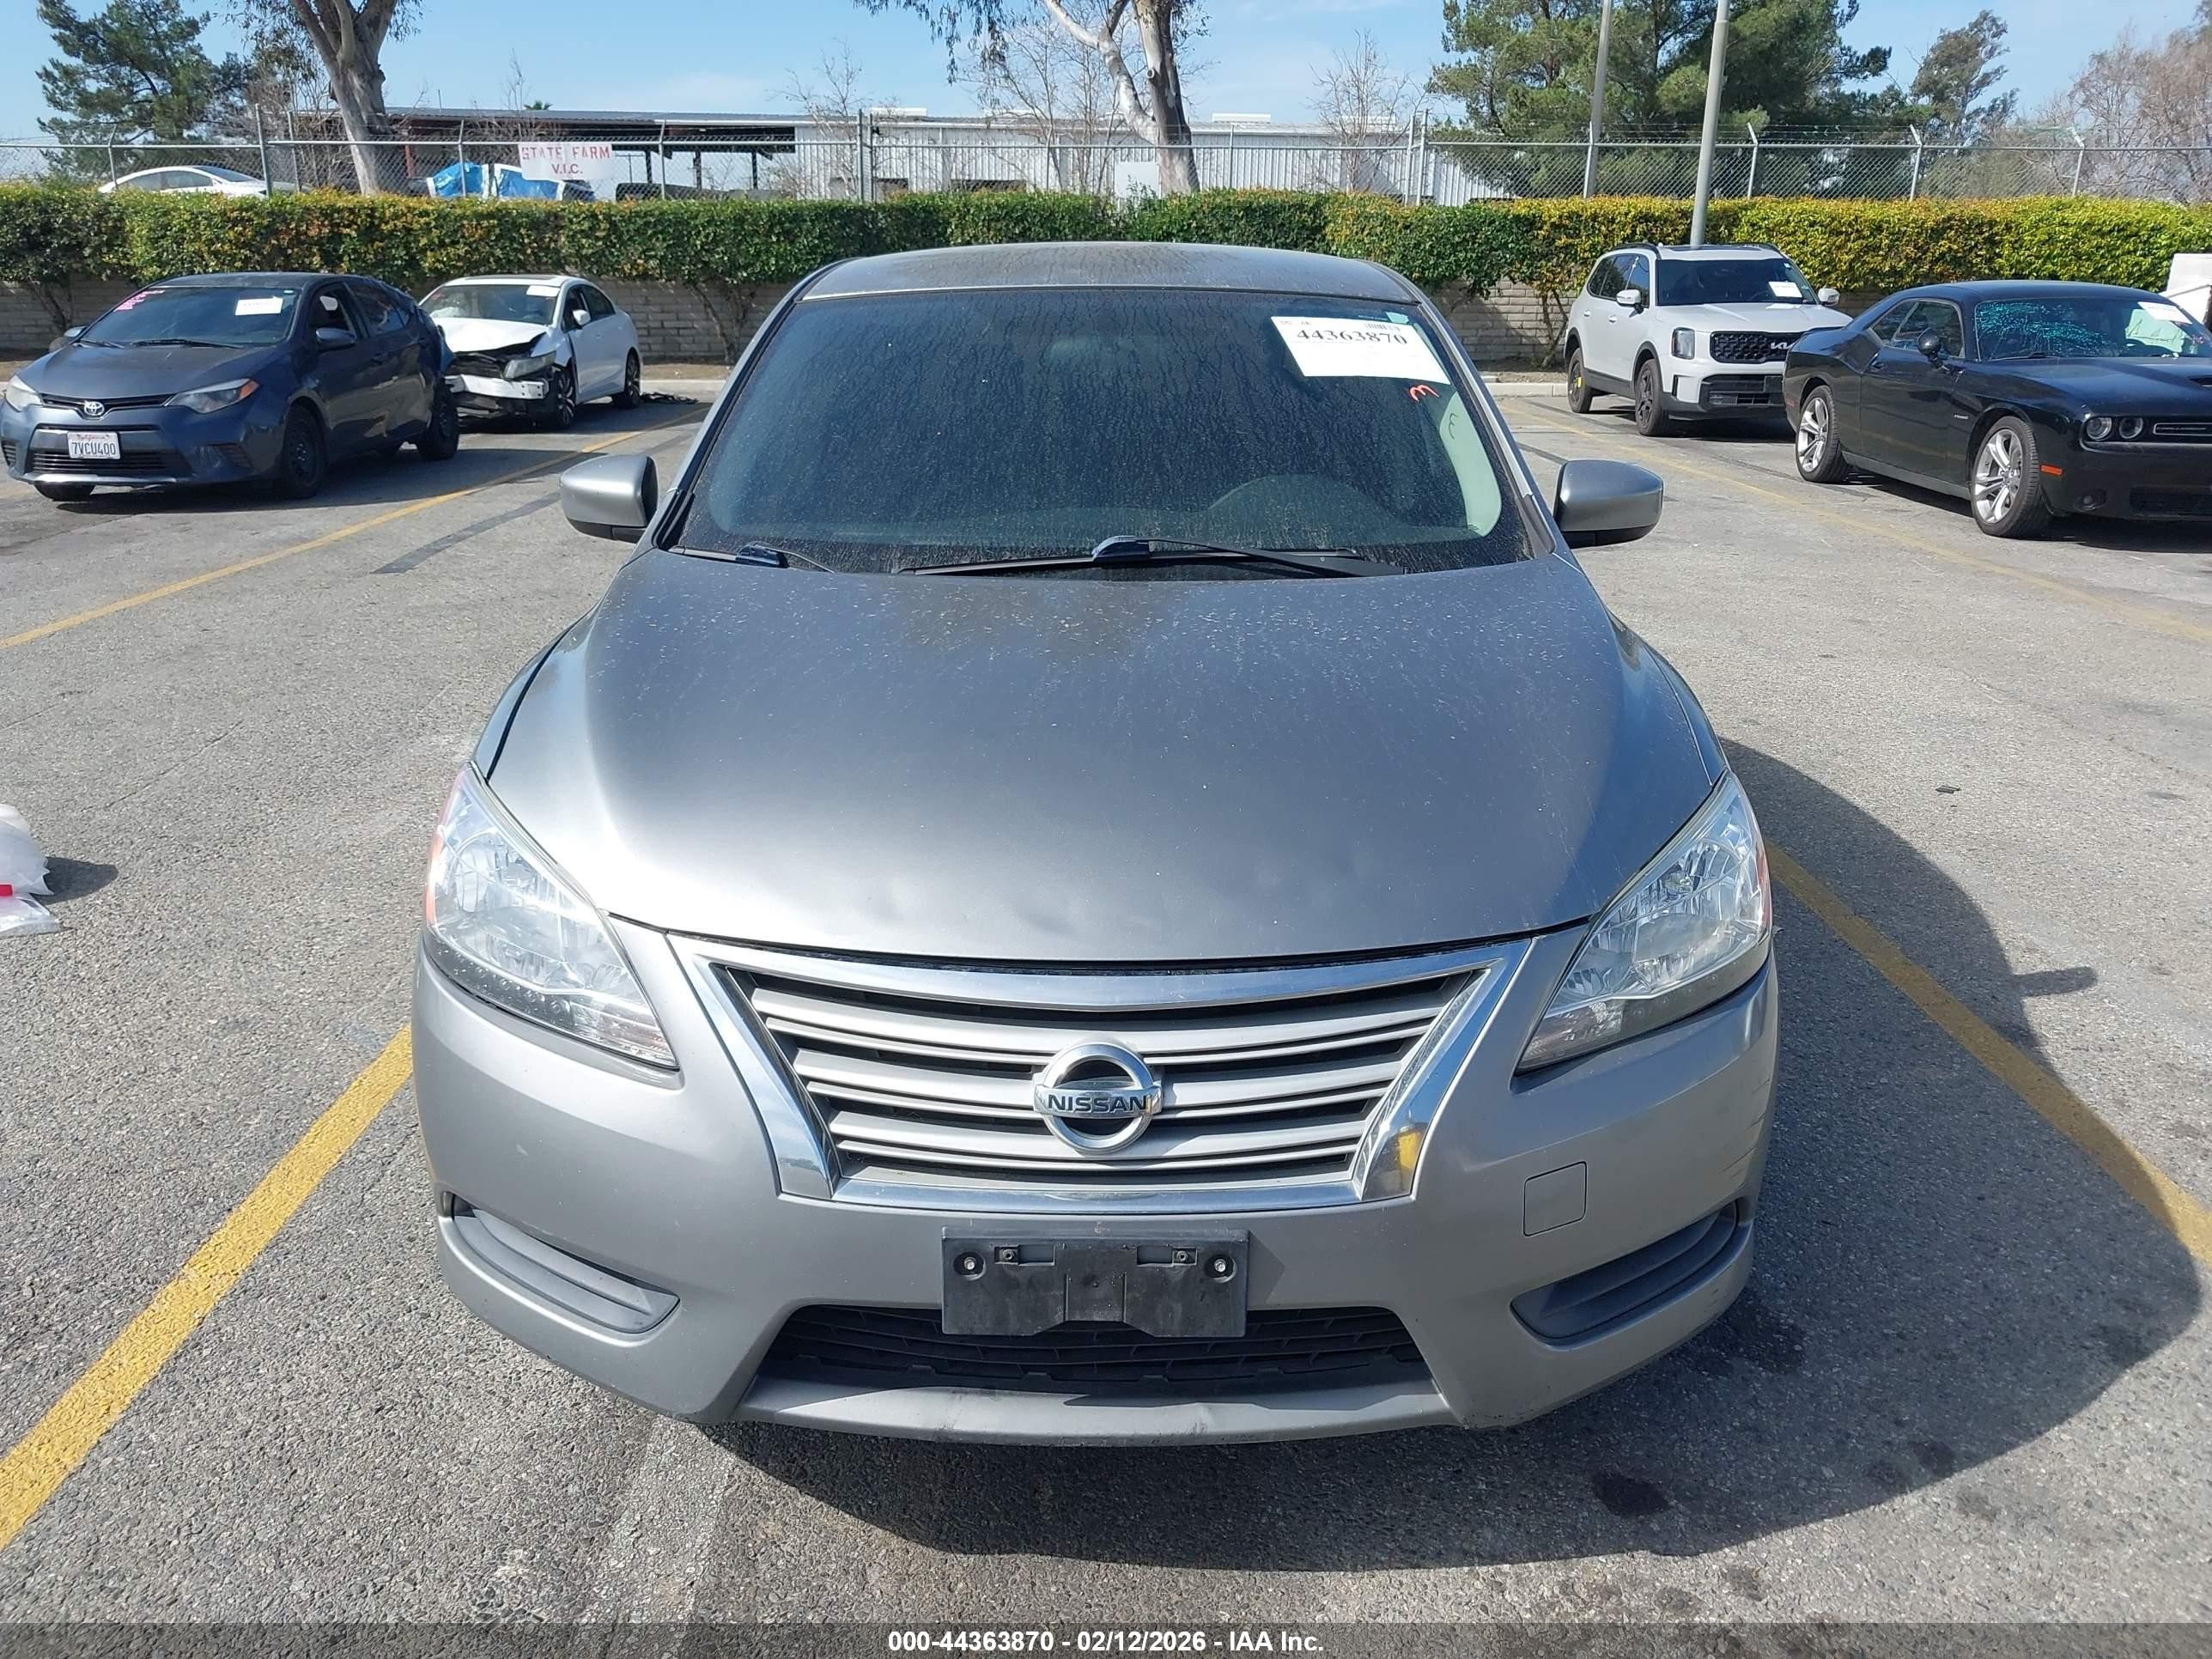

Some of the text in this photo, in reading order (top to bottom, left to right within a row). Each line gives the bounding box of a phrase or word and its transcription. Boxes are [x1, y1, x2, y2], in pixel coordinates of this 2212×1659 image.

[521, 146, 610, 160] STATE FARM
[551, 163, 583, 174] V.I.C.
[1297, 329, 1407, 344] 44363870
[71, 442, 116, 455] 7VCU400
[1048, 1094, 1147, 1114] NISSAN
